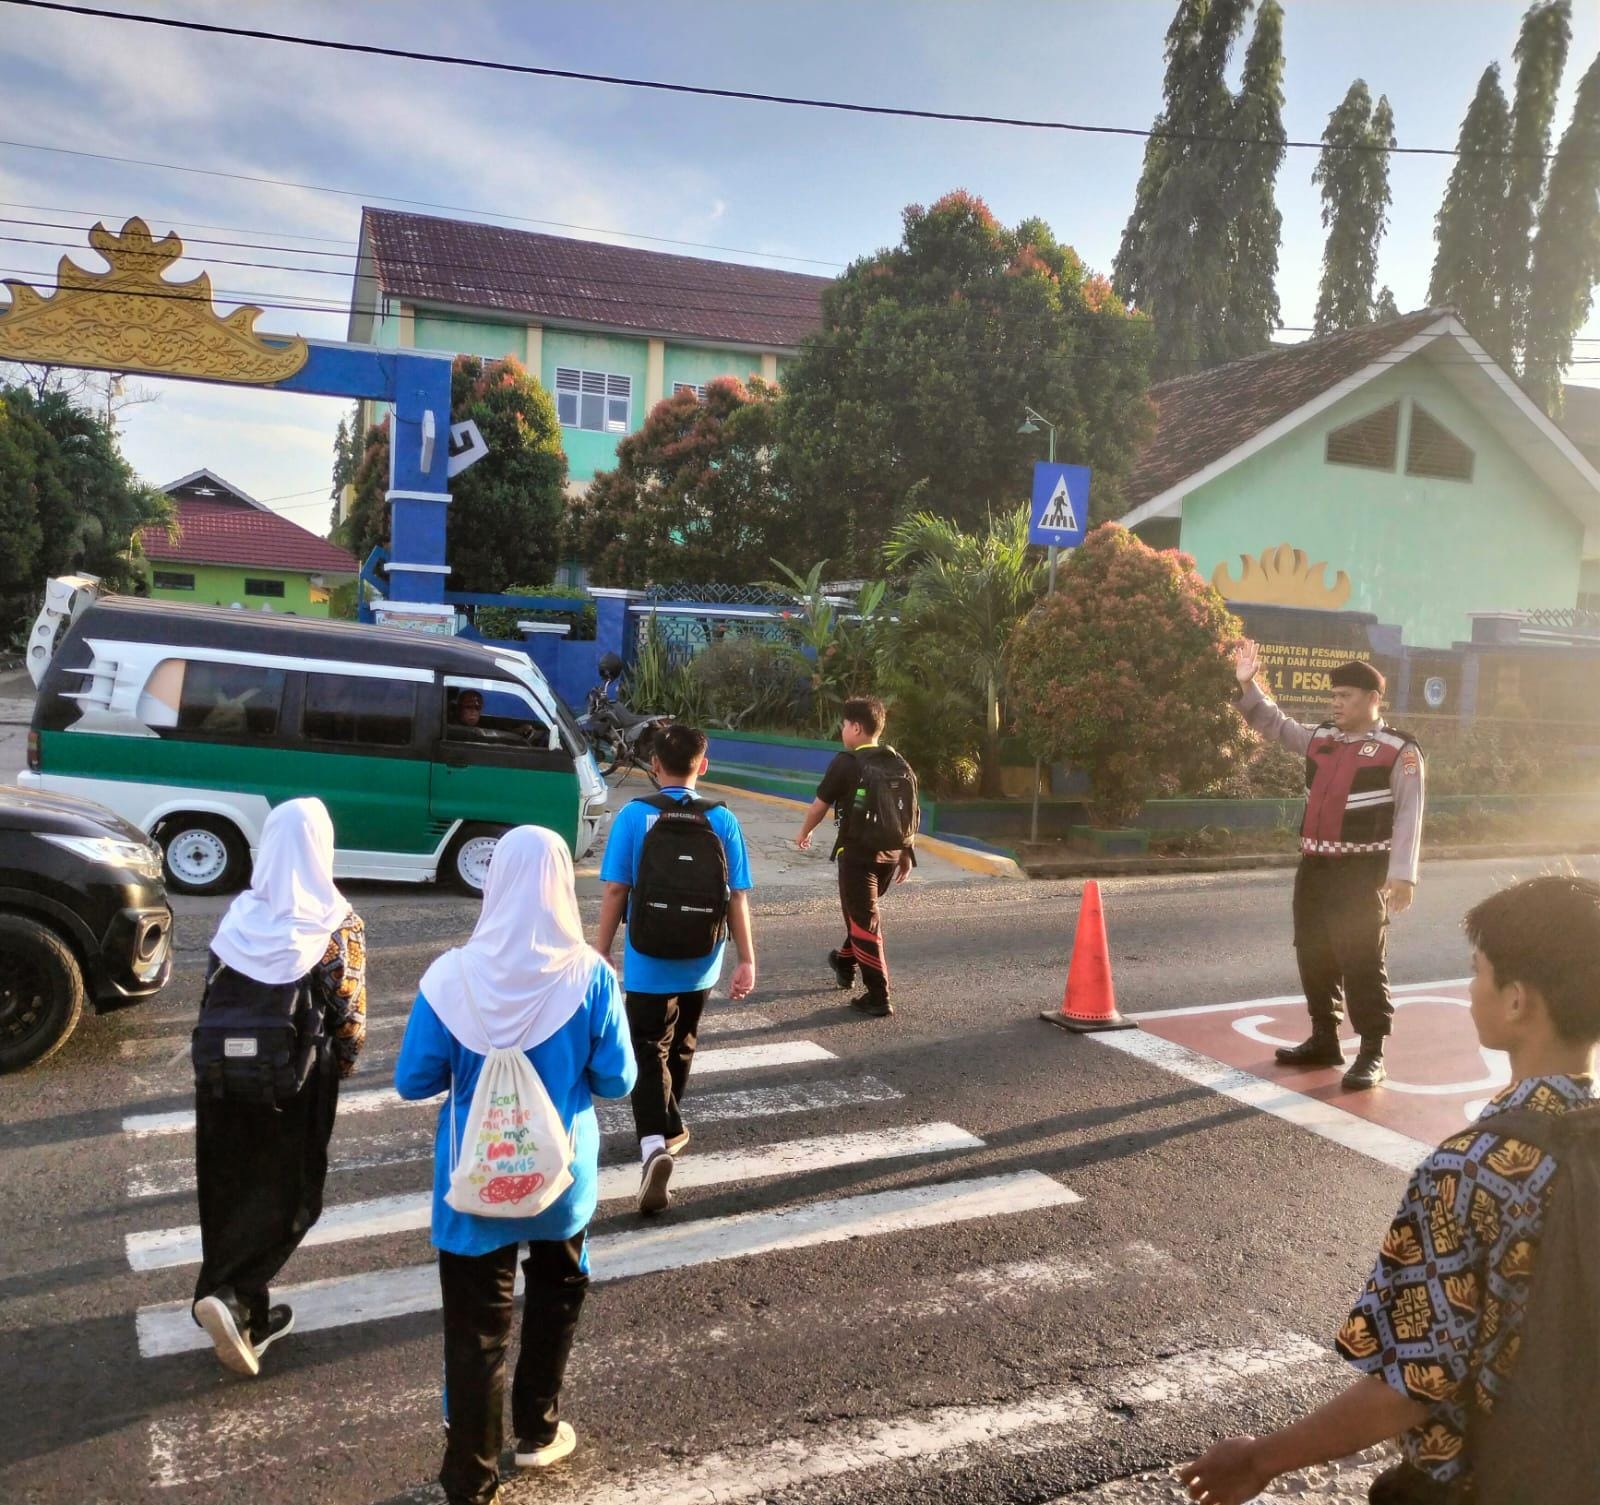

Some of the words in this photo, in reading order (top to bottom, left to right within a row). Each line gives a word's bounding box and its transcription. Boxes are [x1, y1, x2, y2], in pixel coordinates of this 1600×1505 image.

[1255, 643, 1308, 656] ABUPATEN
[1311, 648, 1370, 661] PESAWARAN
[1287, 658, 1306, 666] DAN
[1274, 671, 1284, 689] 1
